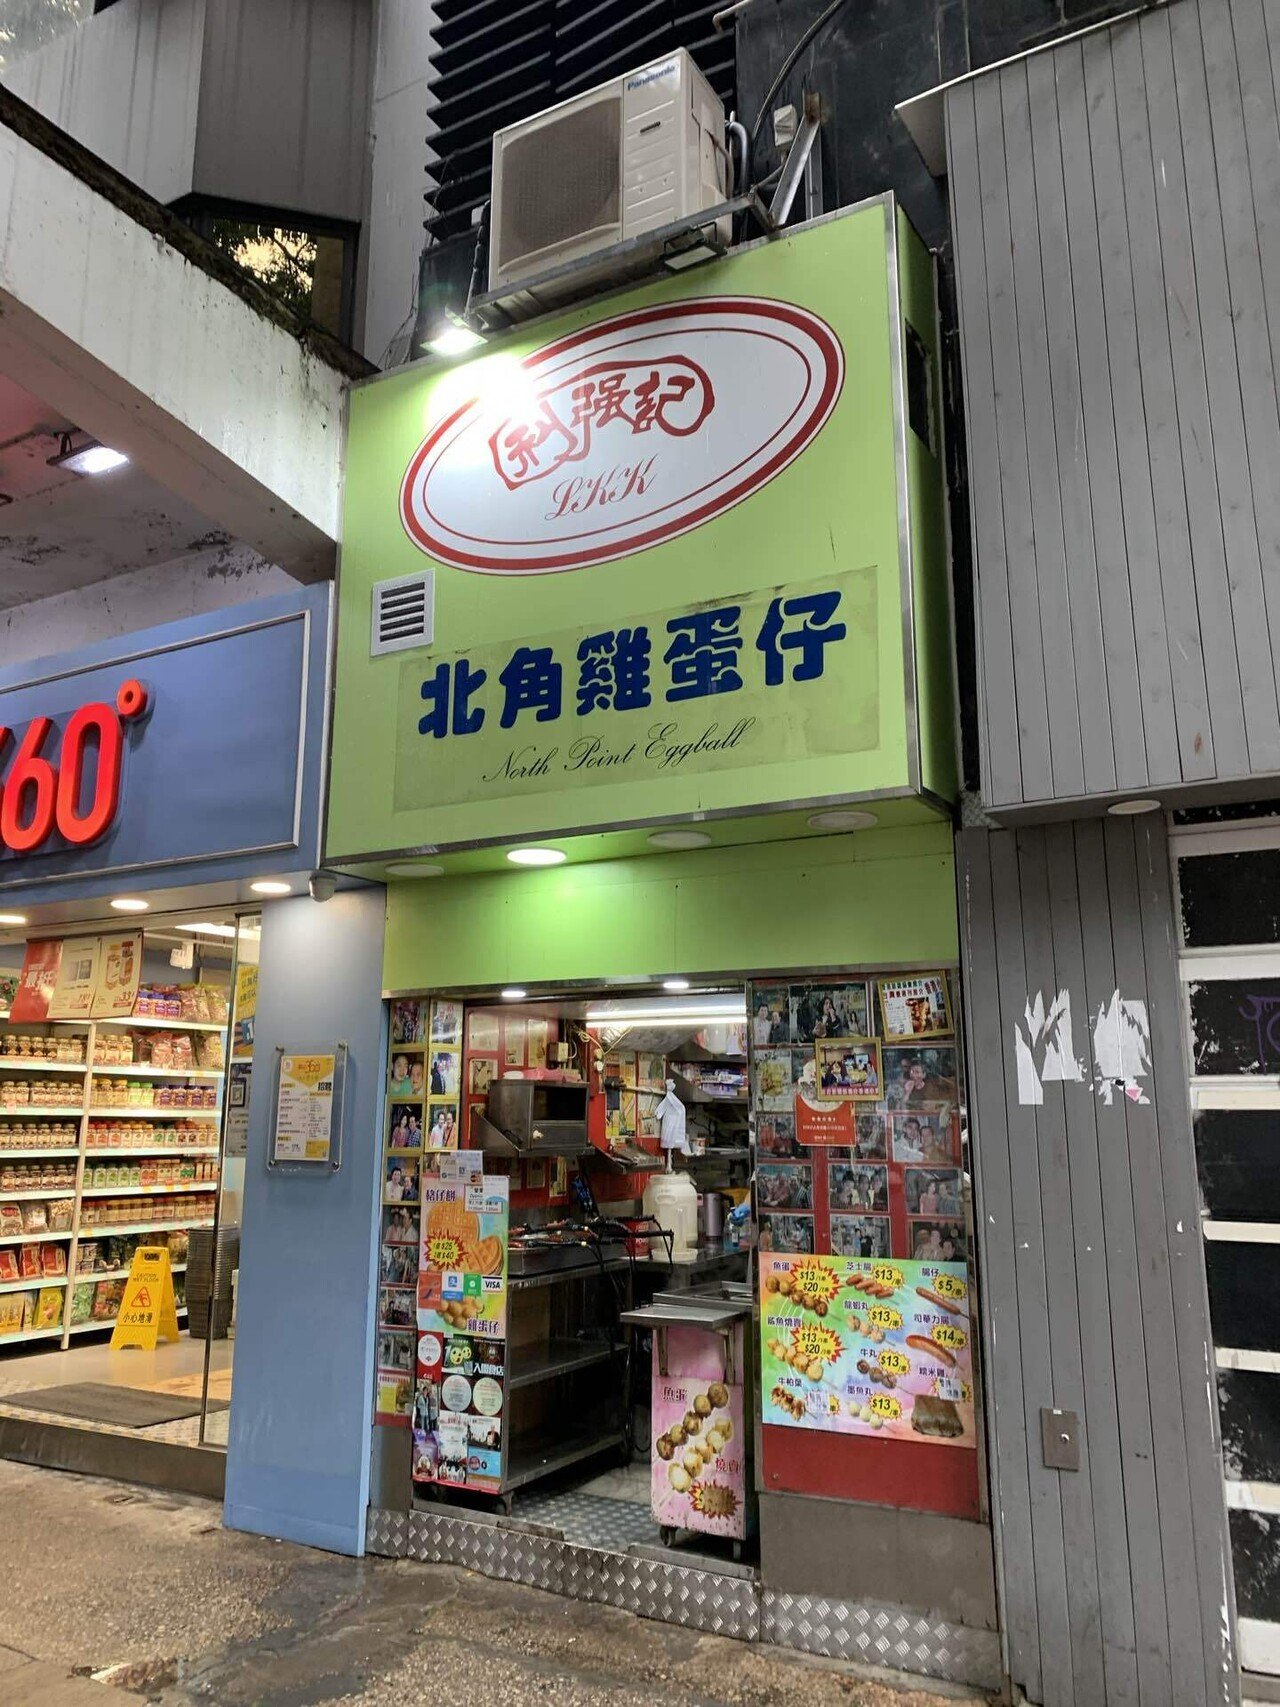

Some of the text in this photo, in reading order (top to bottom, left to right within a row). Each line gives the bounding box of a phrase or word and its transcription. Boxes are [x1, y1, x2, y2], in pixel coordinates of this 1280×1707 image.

[628, 65, 676, 91] Panasonic
[545, 453, 660, 521] LKK
[418, 590, 847, 739] 北角雞蛋仔
[0, 678, 147, 852] 60°
[482, 717, 757, 783] North Point Eggball
[485, 1281, 501, 1289] VISA
[123, 1312, 153, 1324] 小心地滑
[860, 1348, 877, 1358] 牛丸
